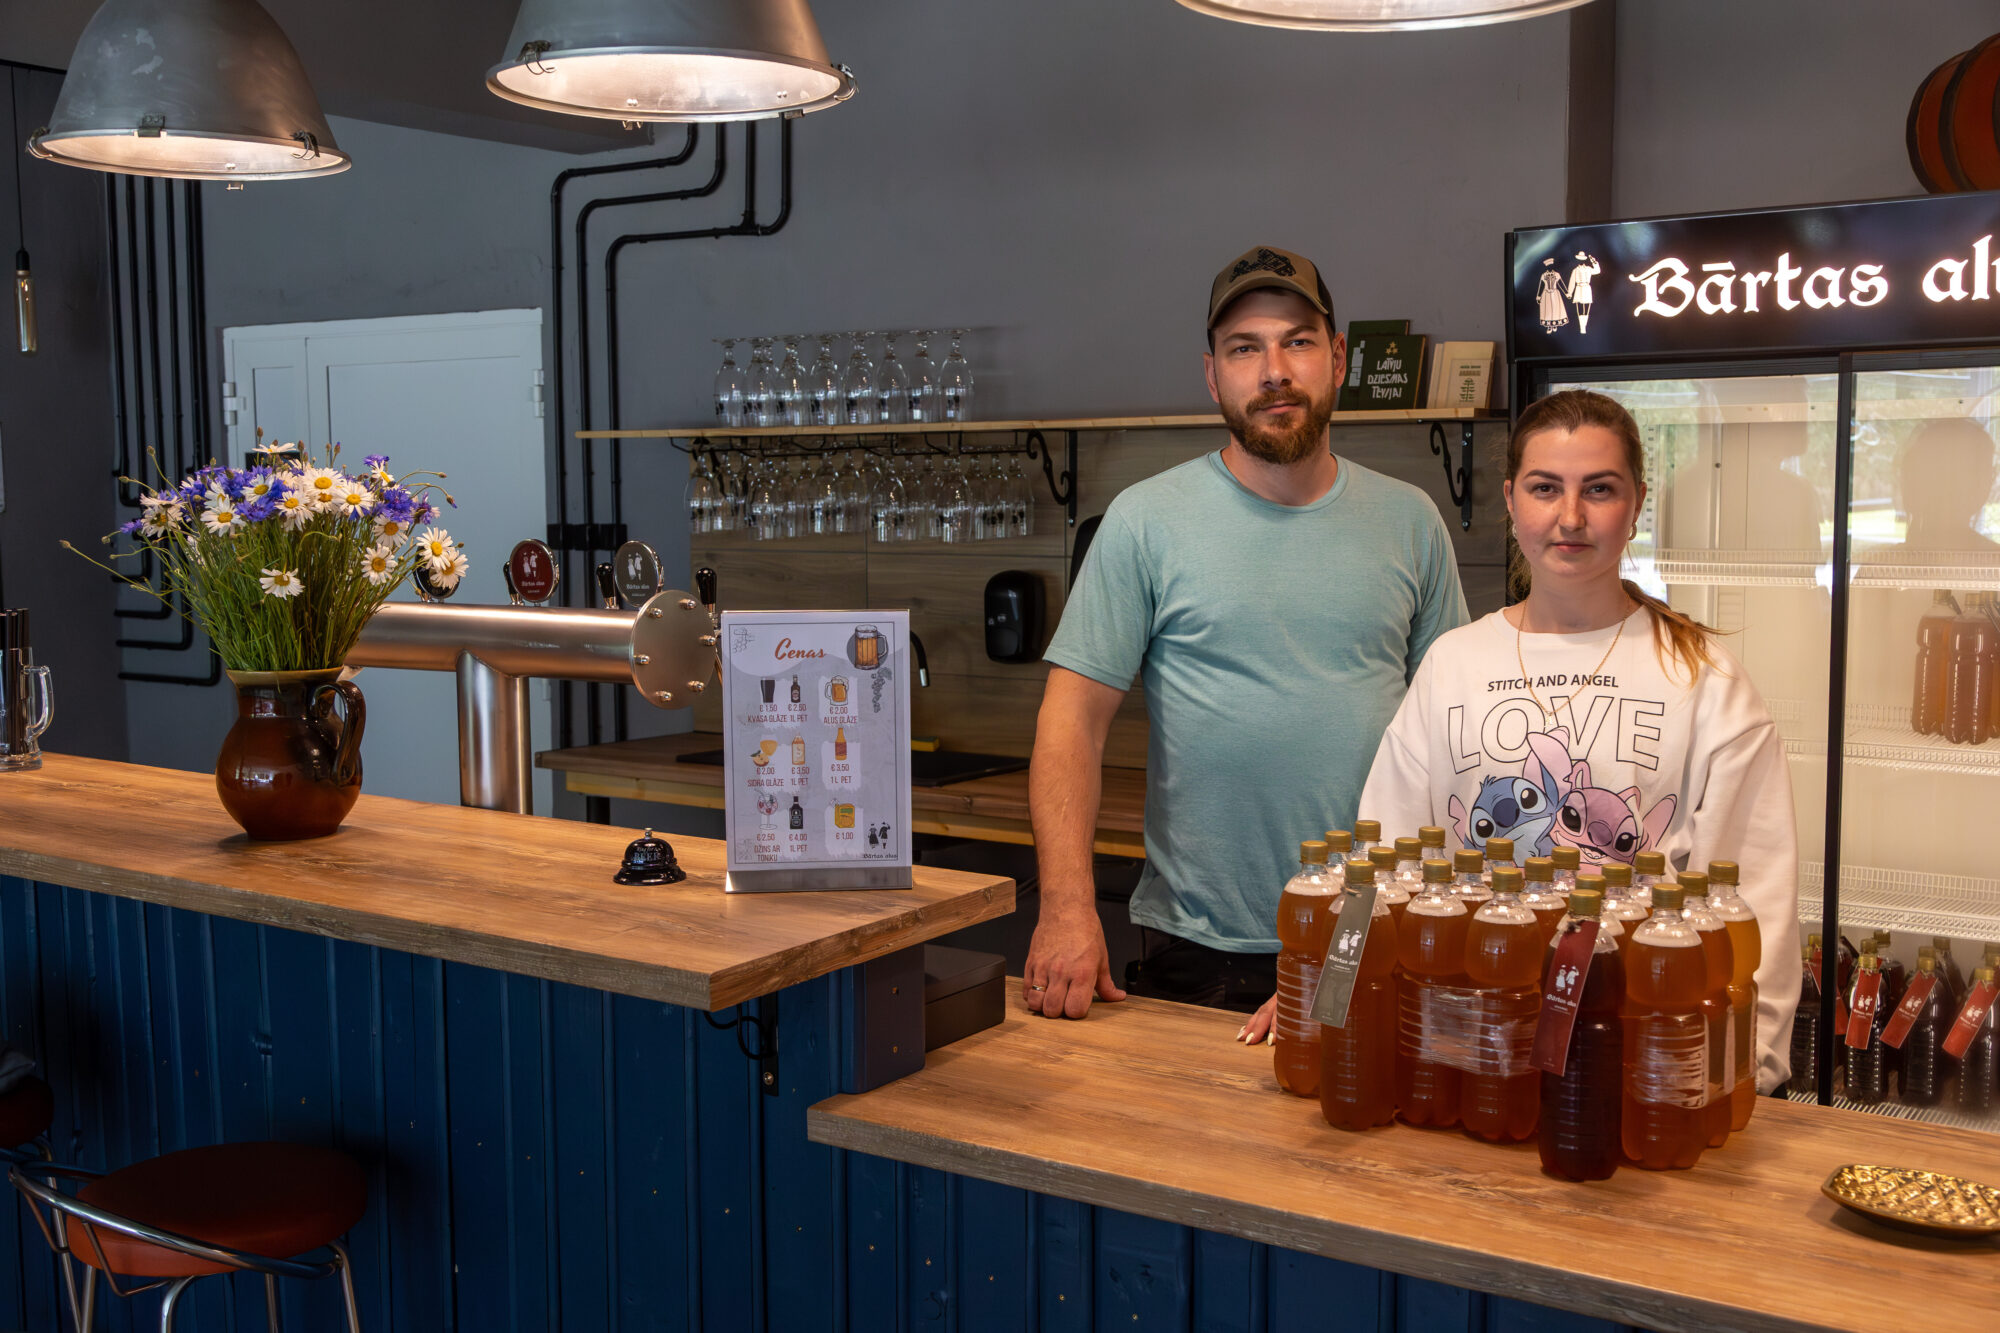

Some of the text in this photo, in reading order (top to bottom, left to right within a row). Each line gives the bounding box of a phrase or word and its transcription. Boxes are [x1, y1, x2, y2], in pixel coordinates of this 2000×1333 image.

[1629, 252, 1889, 317] Bārtas
[1367, 373, 1408, 384] DZIESMAS
[774, 637, 826, 660] Cenas
[1487, 674, 1619, 692] STITCH AND ANGEL
[747, 715, 768, 723] KVASA
[796, 714, 808, 722] PET
[824, 716, 839, 724] ALUS
[1448, 696, 1665, 775] LOVE
[747, 779, 764, 787] SIDRA
[797, 777, 808, 785] PET
[840, 776, 852, 784] PET
[796, 844, 808, 852] PET
[757, 854, 778, 862] TONIKU
